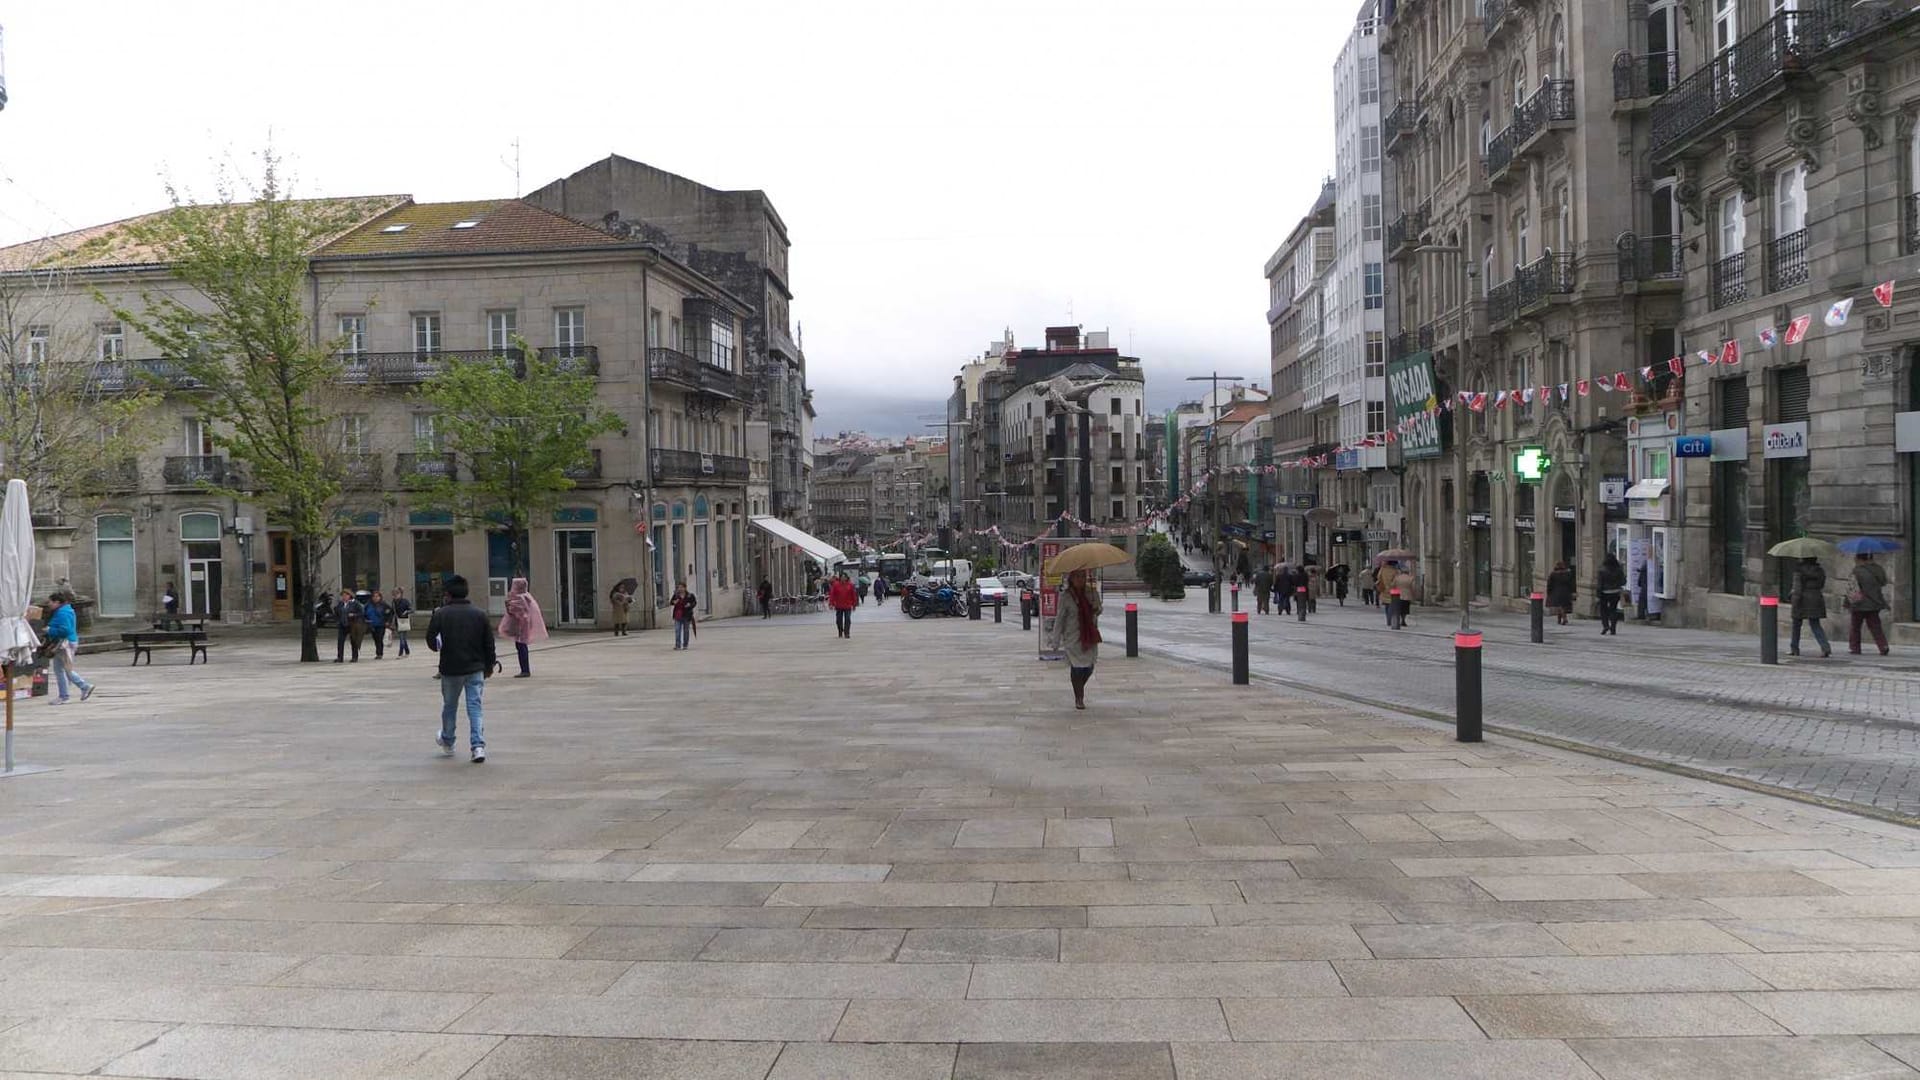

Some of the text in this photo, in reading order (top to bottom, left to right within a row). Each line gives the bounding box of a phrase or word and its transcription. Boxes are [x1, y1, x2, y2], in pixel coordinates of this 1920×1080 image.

[1390, 362, 1432, 407] POSADA
[1682, 439, 1705, 453] citi
[1768, 430, 1803, 450] citibank
